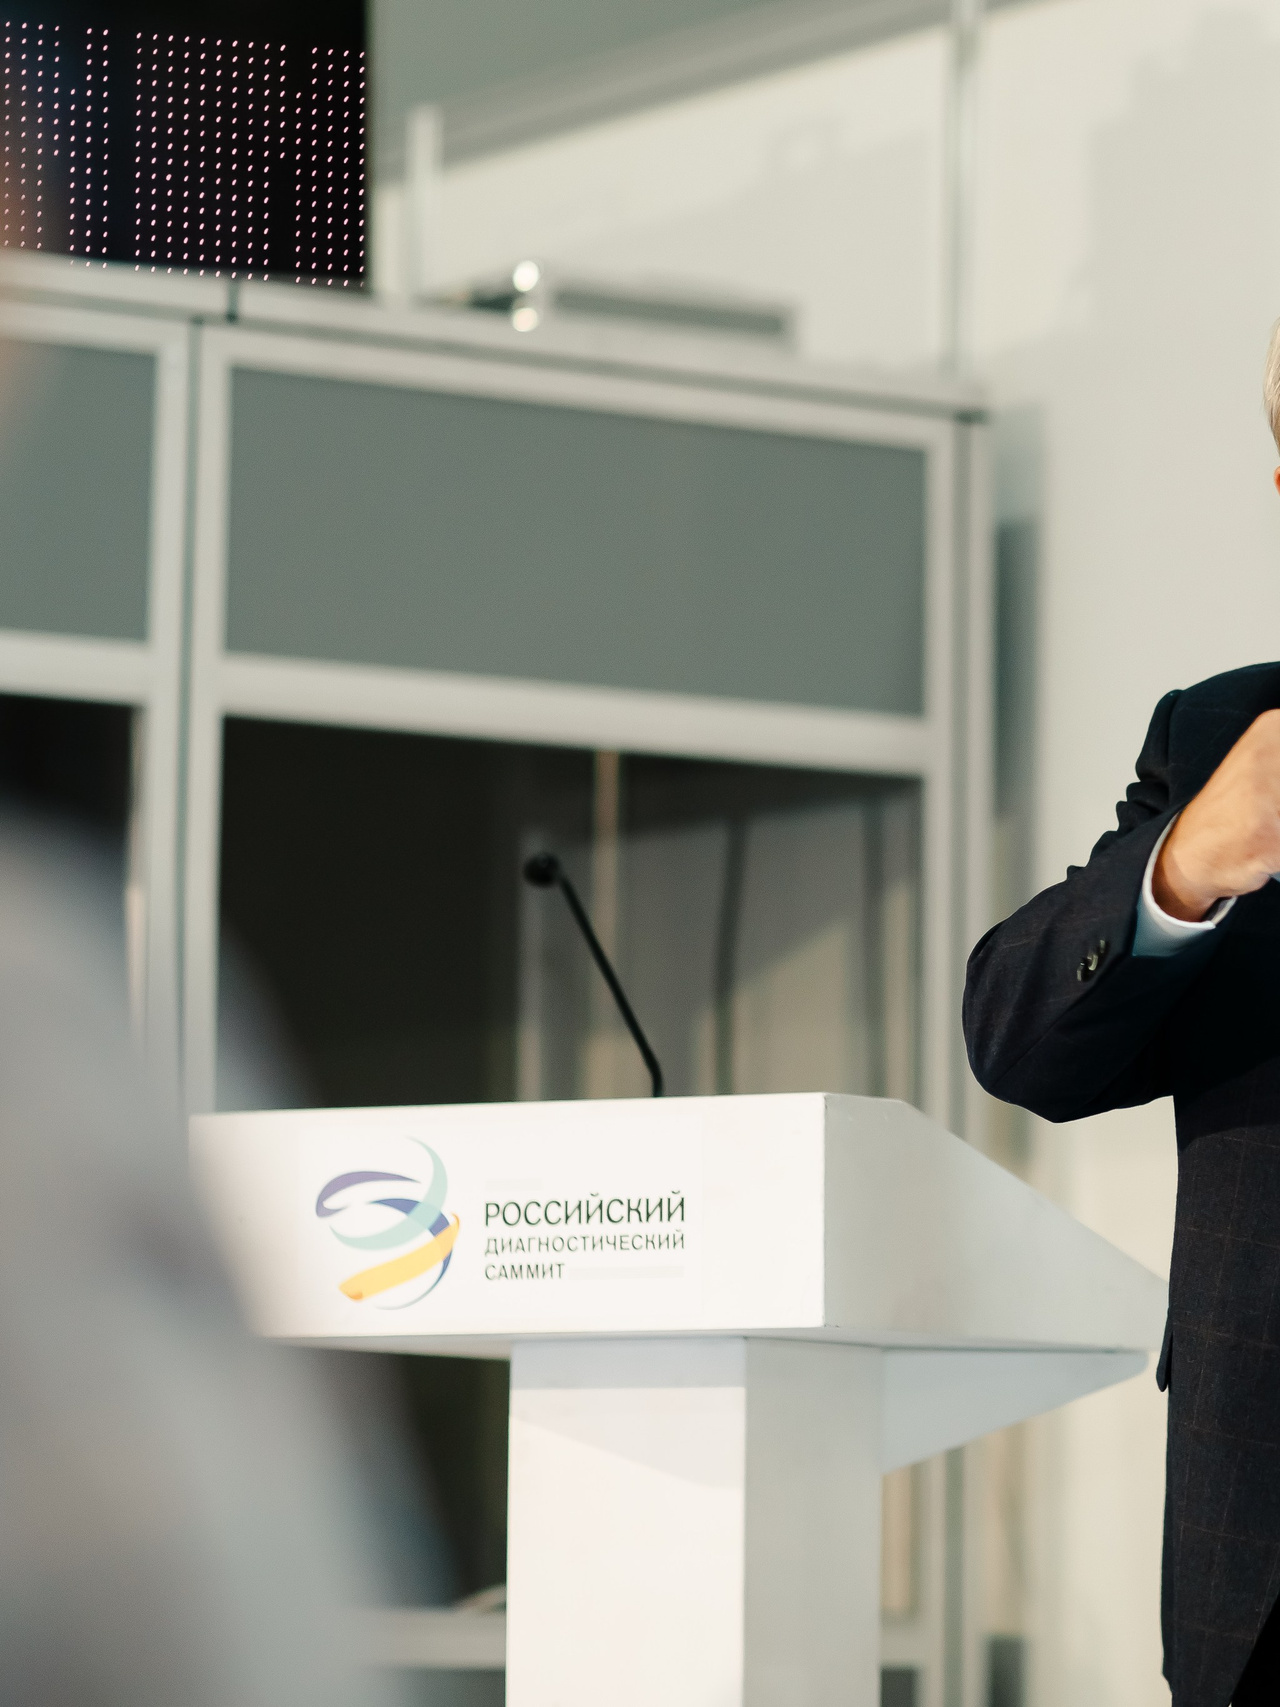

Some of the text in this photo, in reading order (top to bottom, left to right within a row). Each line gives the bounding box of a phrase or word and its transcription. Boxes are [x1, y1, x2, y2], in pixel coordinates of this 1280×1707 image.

[484, 1189, 685, 1227] РОССИЙСКИЙ
[484, 1229, 685, 1256] ДИАГНОСТИЧЕСКИЙ
[484, 1263, 565, 1281] САММИТ
